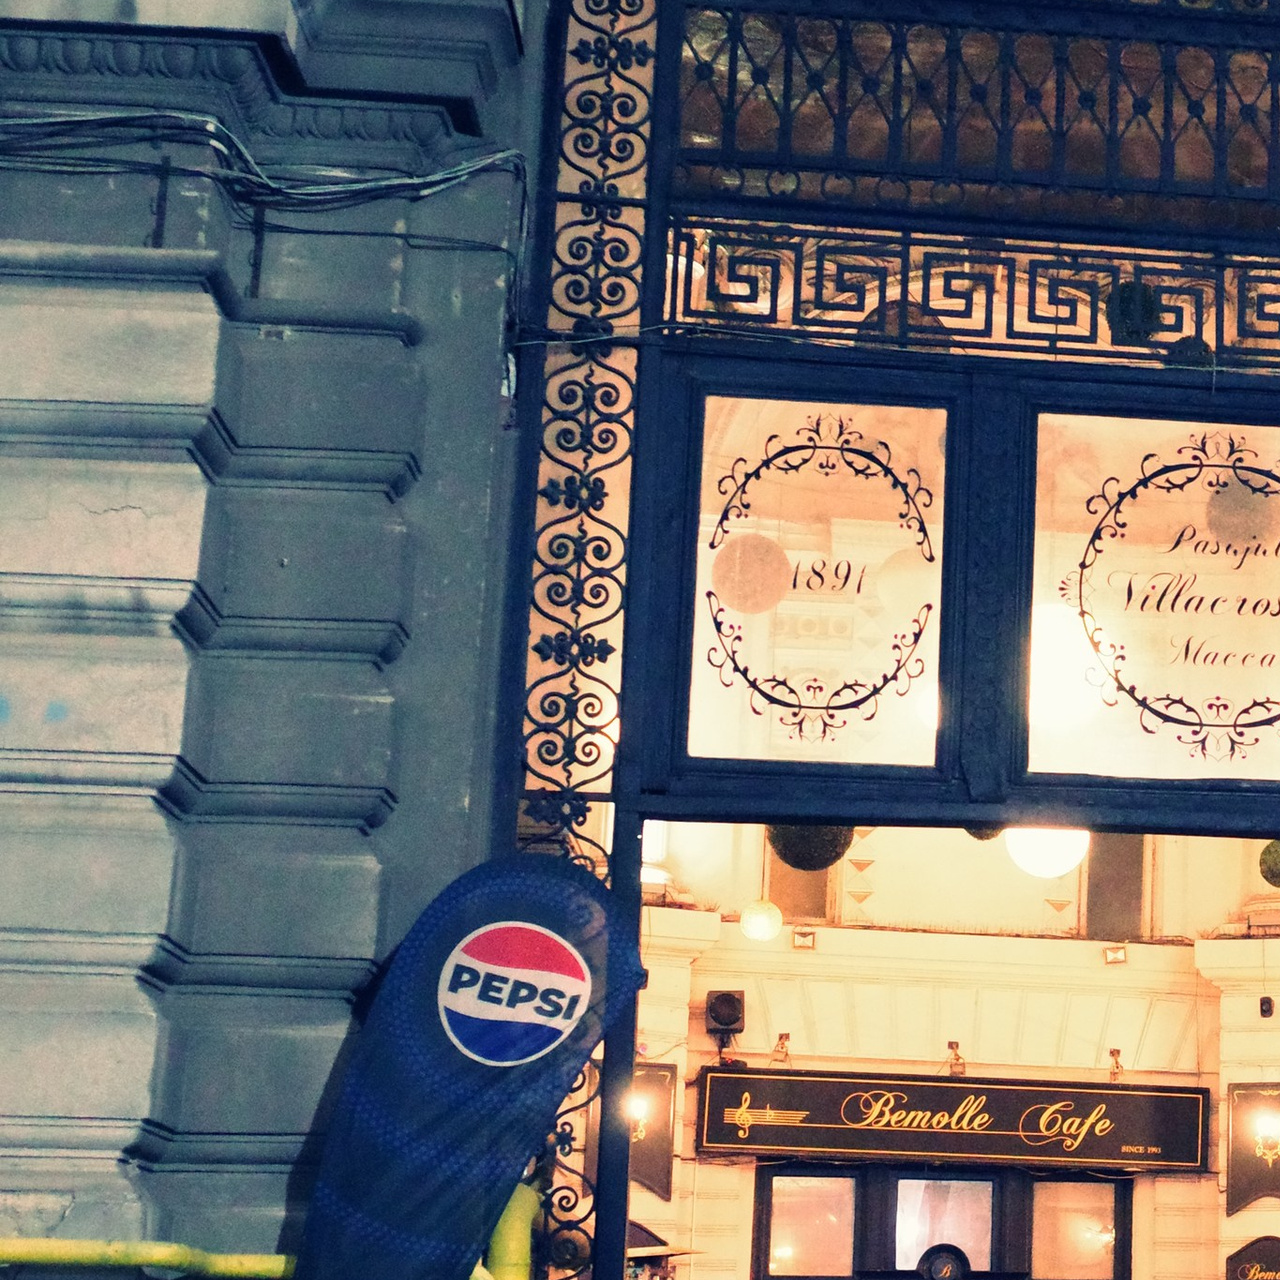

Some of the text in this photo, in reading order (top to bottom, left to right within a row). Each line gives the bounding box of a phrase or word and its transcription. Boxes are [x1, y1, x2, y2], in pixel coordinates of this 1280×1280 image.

[791, 559, 867, 594] 1891
[1170, 635, 1277, 668] Macca
[447, 963, 582, 1021] PEPSI
[841, 1090, 1115, 1152] Bemolle Cafe
[1121, 1145, 1145, 1154] SINCE
